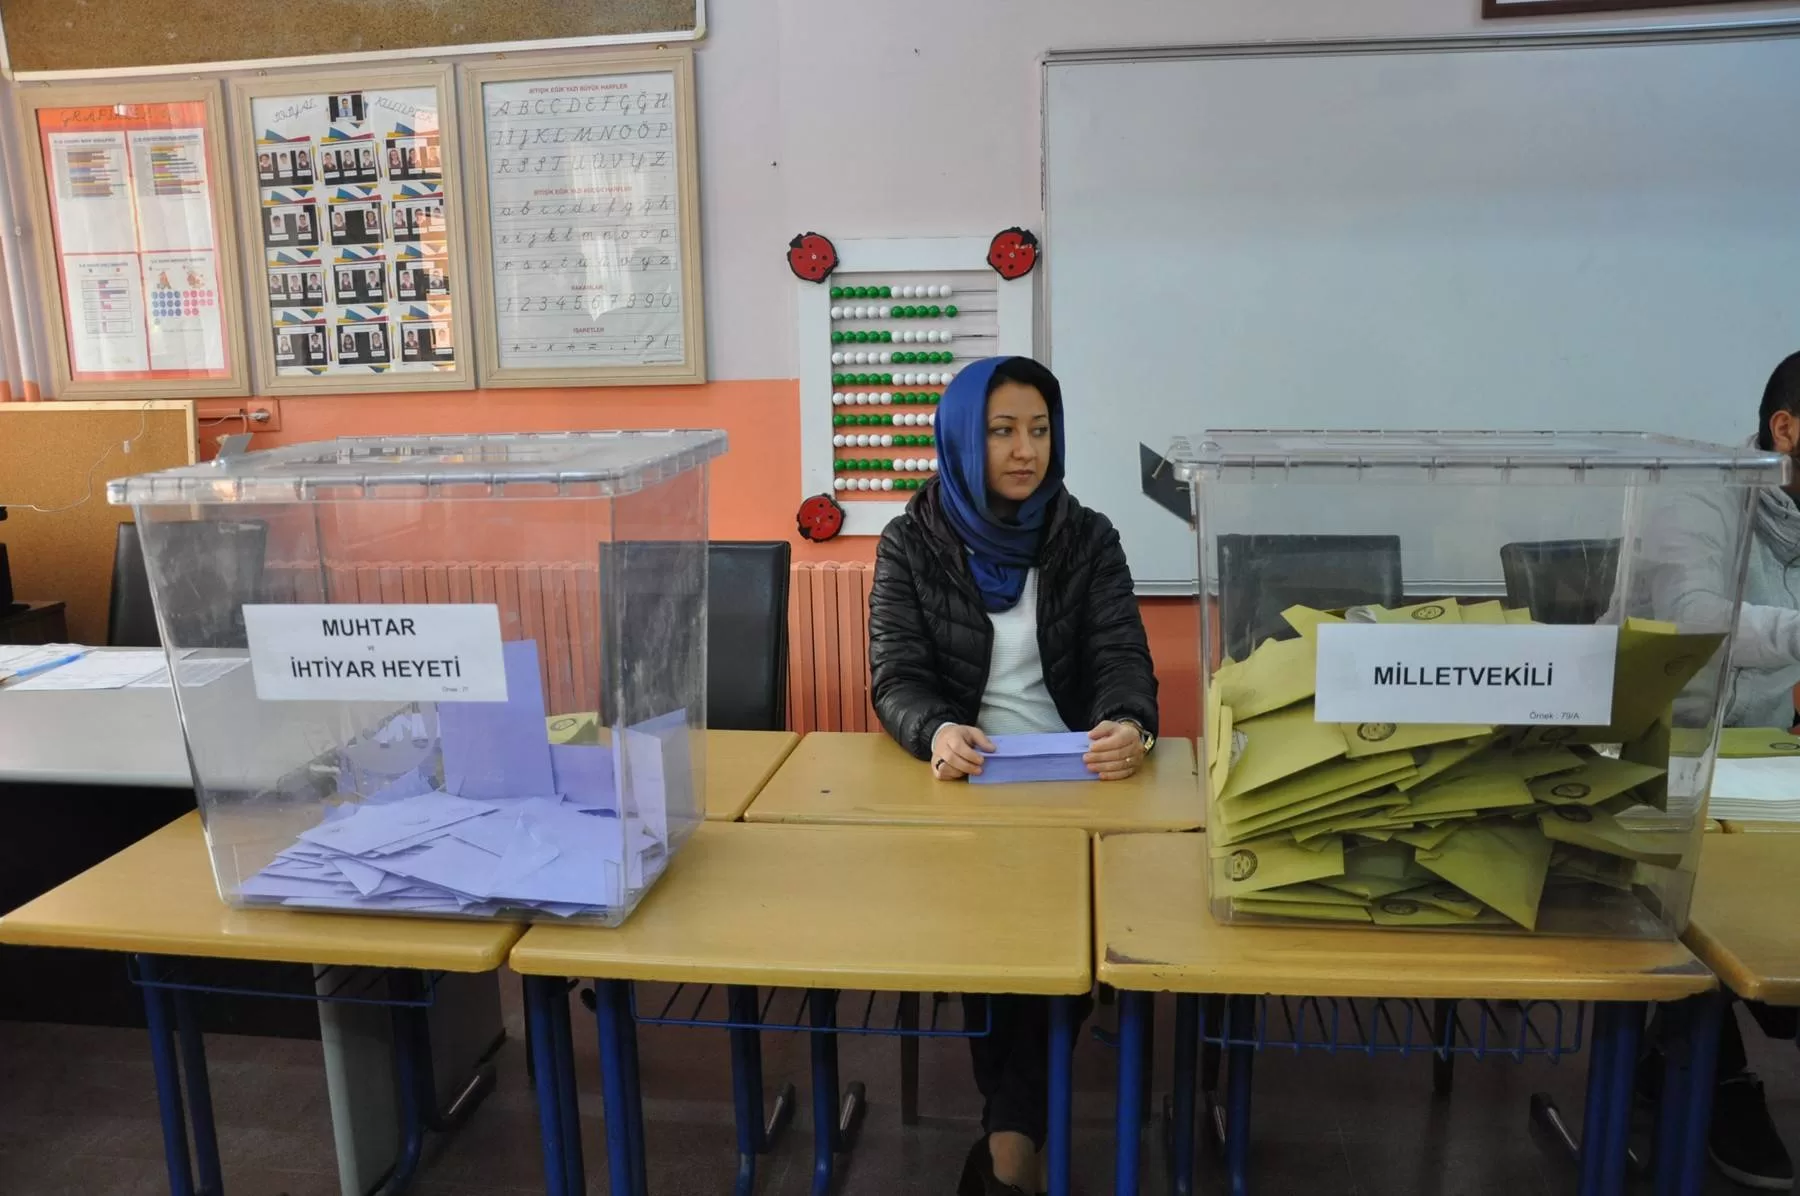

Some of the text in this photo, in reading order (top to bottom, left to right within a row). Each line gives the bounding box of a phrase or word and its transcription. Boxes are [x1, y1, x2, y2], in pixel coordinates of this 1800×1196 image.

[322, 618, 416, 636] MUHTAR
[291, 656, 461, 678] İHTİYAR HEYETİ
[1373, 662, 1553, 686] MİLLETVEKİLİ
[1529, 711, 1553, 719] Örnek
